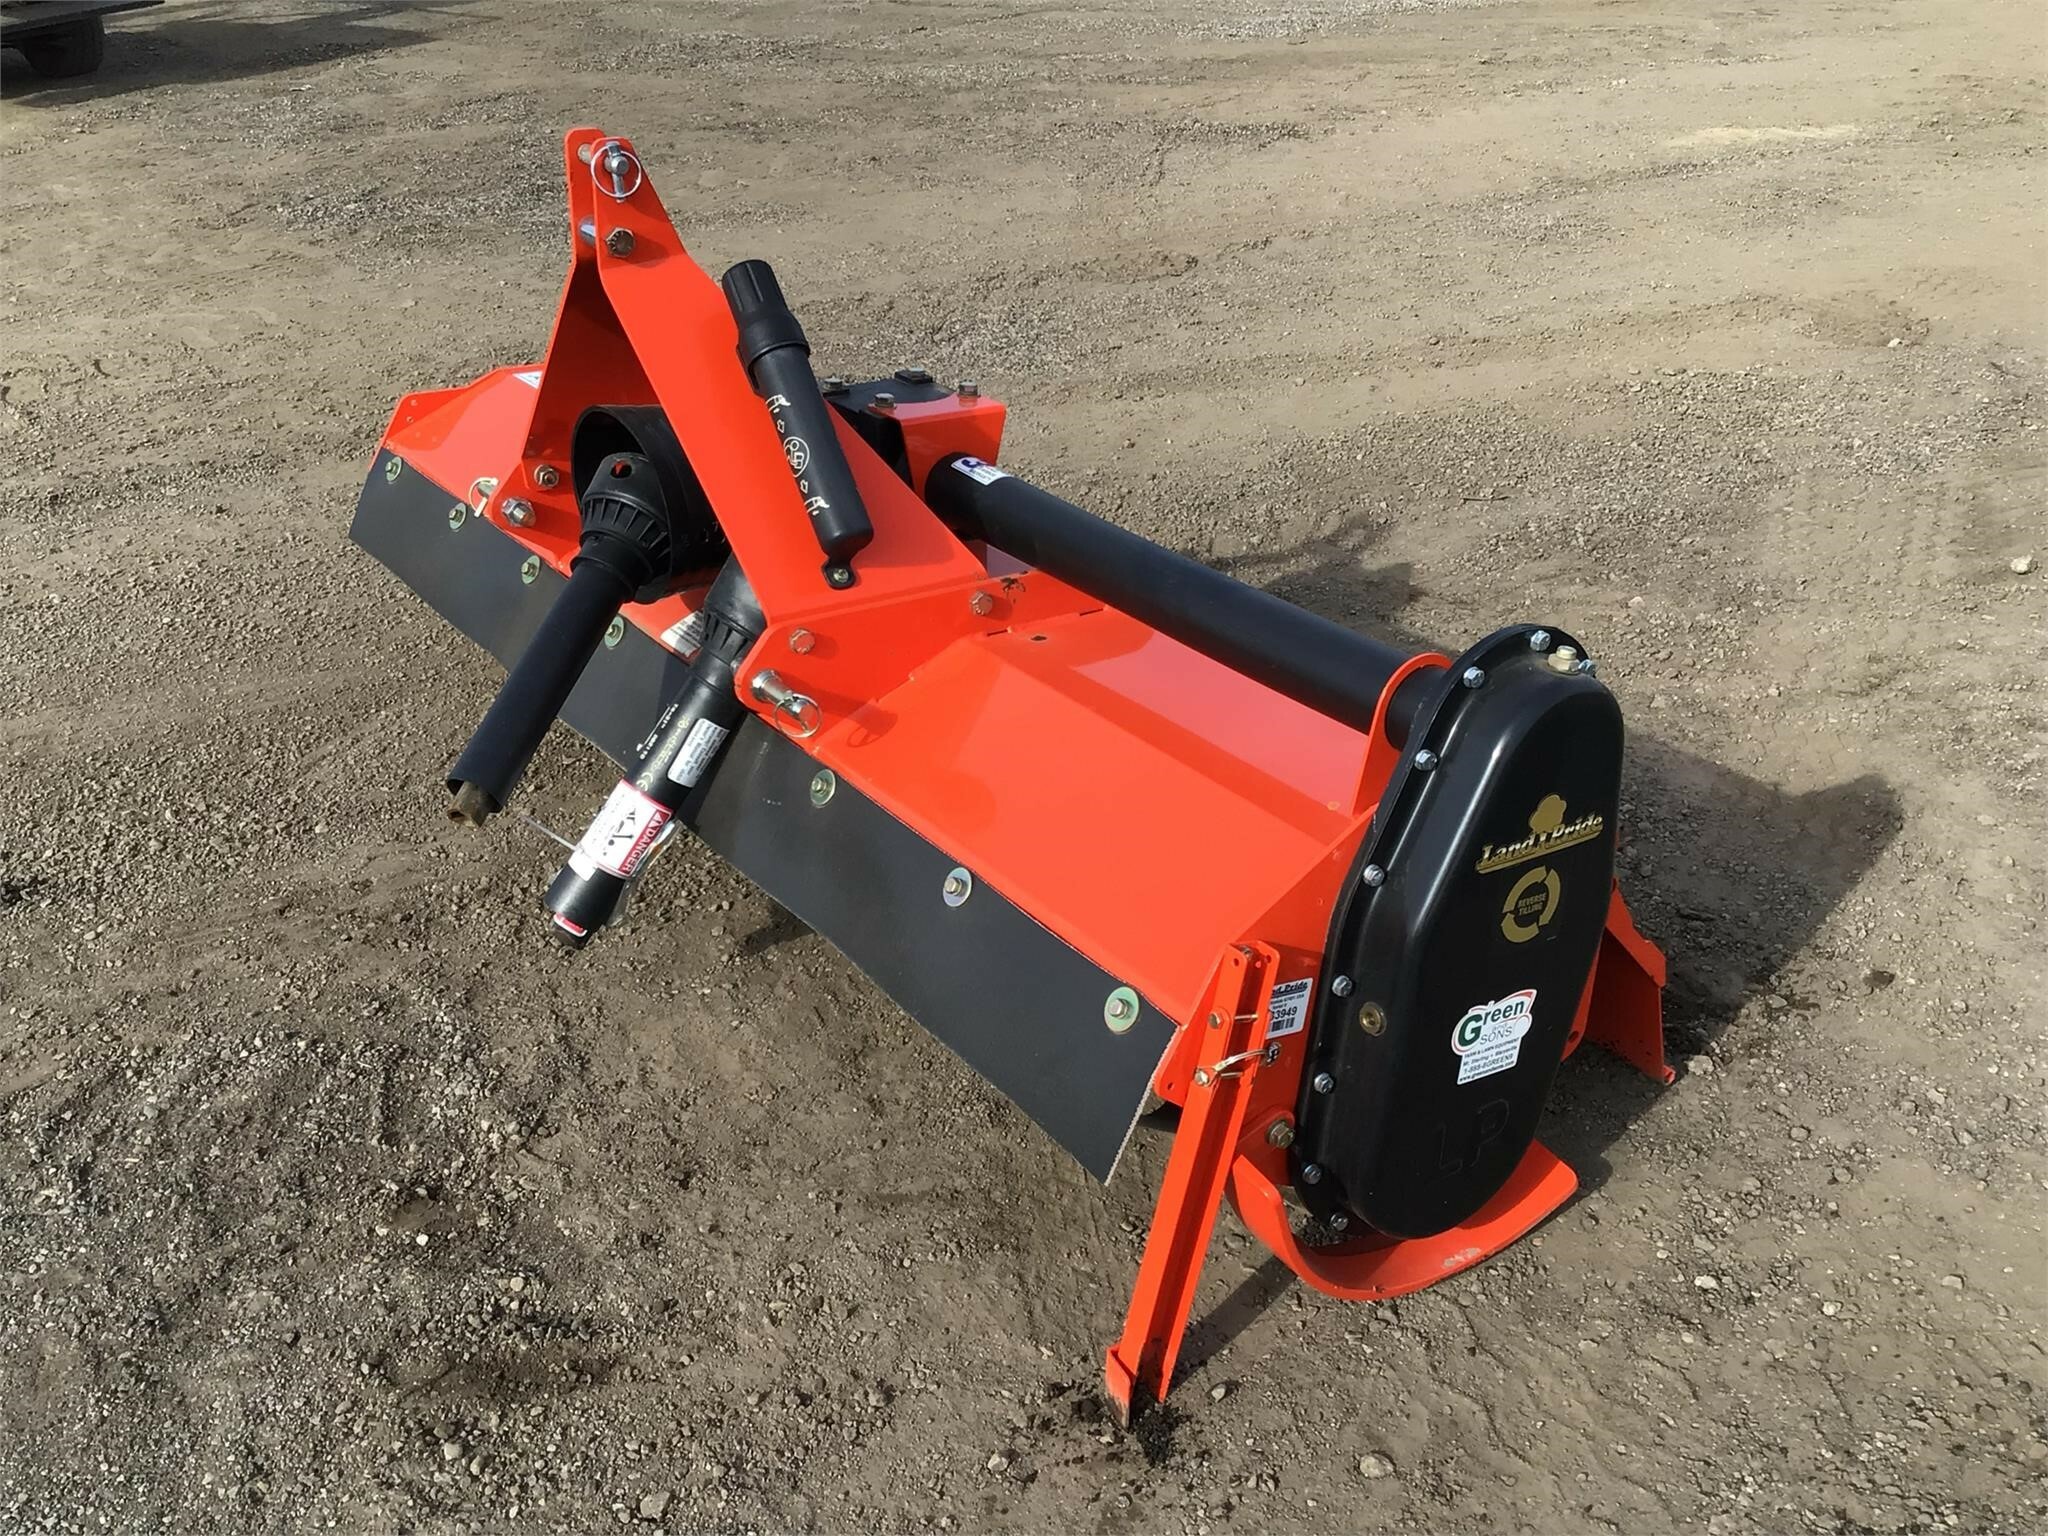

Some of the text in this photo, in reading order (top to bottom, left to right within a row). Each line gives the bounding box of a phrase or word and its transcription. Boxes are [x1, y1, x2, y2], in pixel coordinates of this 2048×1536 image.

[622, 826, 660, 872] DANGER
[1480, 811, 1604, 865] Land Pride
[1518, 892, 1547, 916] REVERSE TILLING
[1458, 1000, 1525, 1047] Green
[1480, 1026, 1513, 1045] SONS
